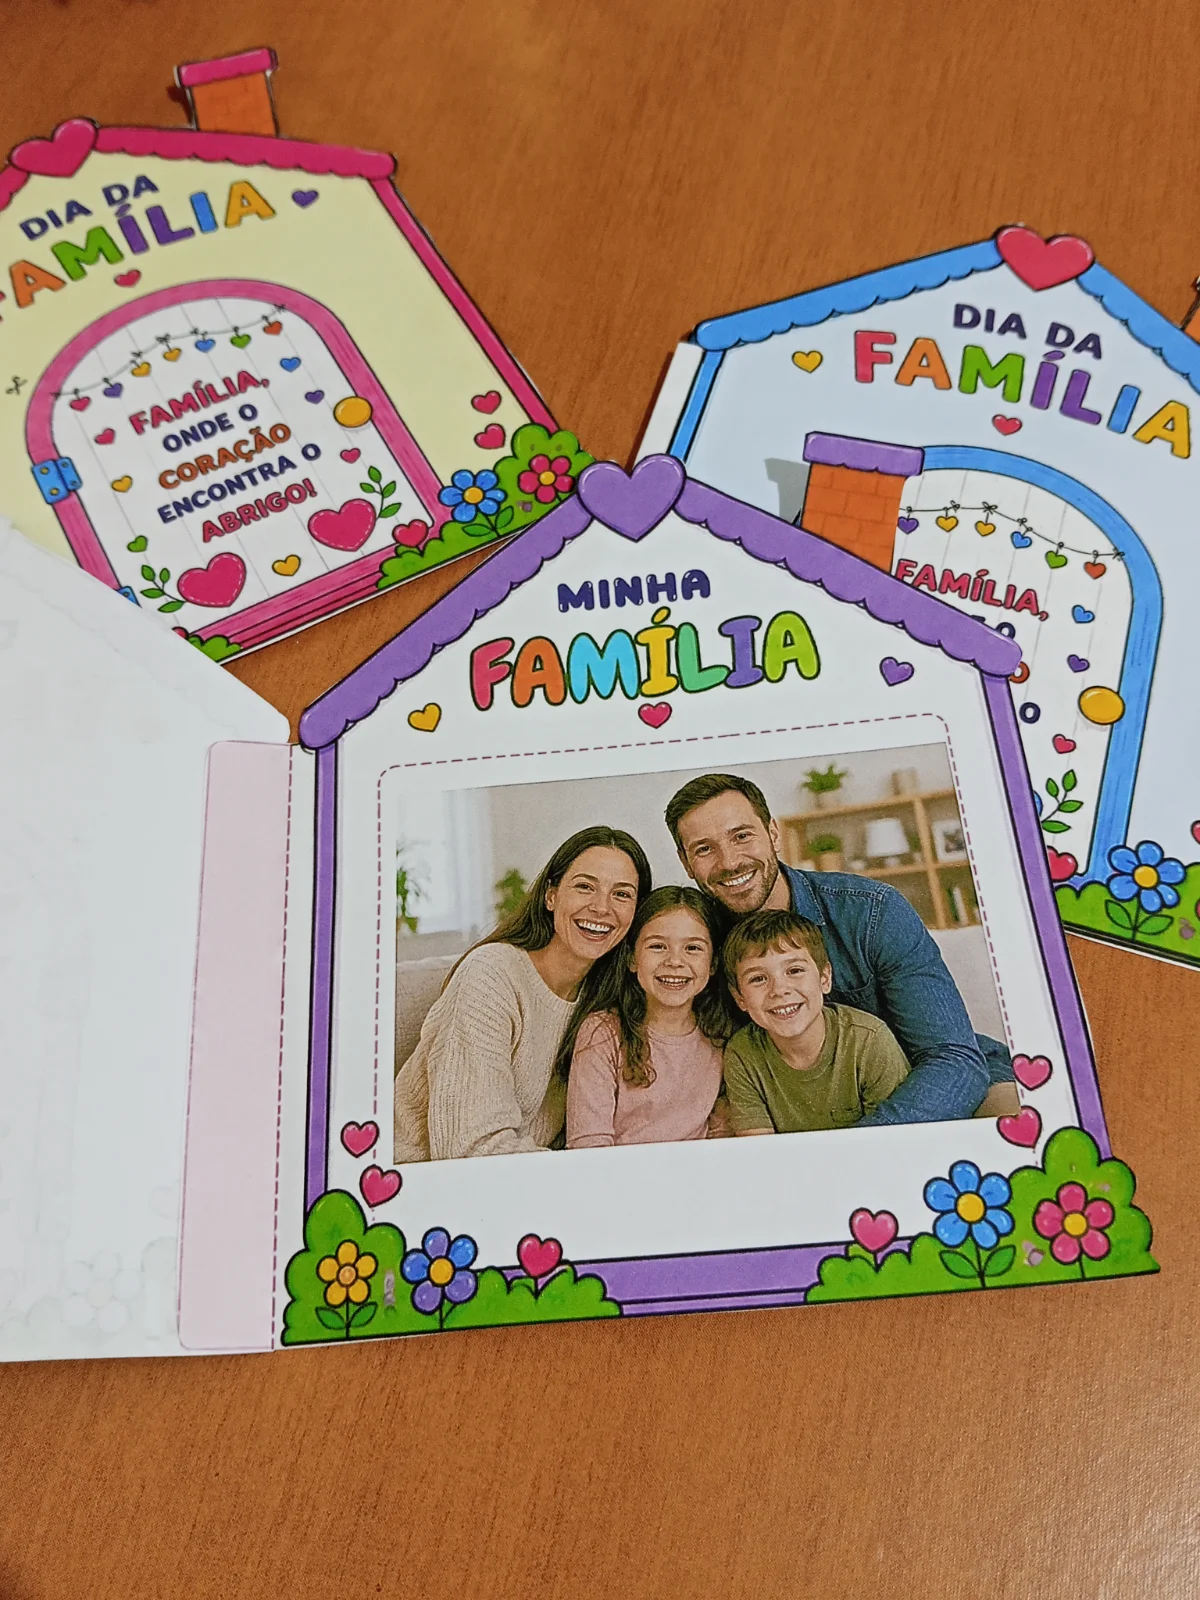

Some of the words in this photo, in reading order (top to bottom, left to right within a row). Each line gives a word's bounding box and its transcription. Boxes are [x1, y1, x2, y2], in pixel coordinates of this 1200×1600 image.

[19, 200, 93, 241] DIA
[102, 175, 159, 207] DA
[0, 180, 277, 322] AMÍLIA
[953, 303, 1027, 339] DIA
[1044, 322, 1102, 360] DA
[128, 370, 270, 436] FAMÍLIA,
[854, 329, 1191, 459] FAMÍLIA
[158, 423, 292, 490] CORAÇÃO
[162, 412, 235, 453] ONDE
[238, 403, 258, 422] O
[157, 455, 297, 524] ENCONTRA
[301, 443, 321, 461] O
[202, 478, 318, 543] ABRIGO!
[557, 569, 711, 613] MINHA
[894, 558, 1049, 622] FAMÍLIA,
[470, 606, 821, 711] FAMÍLIA
[1019, 702, 1041, 724] O
